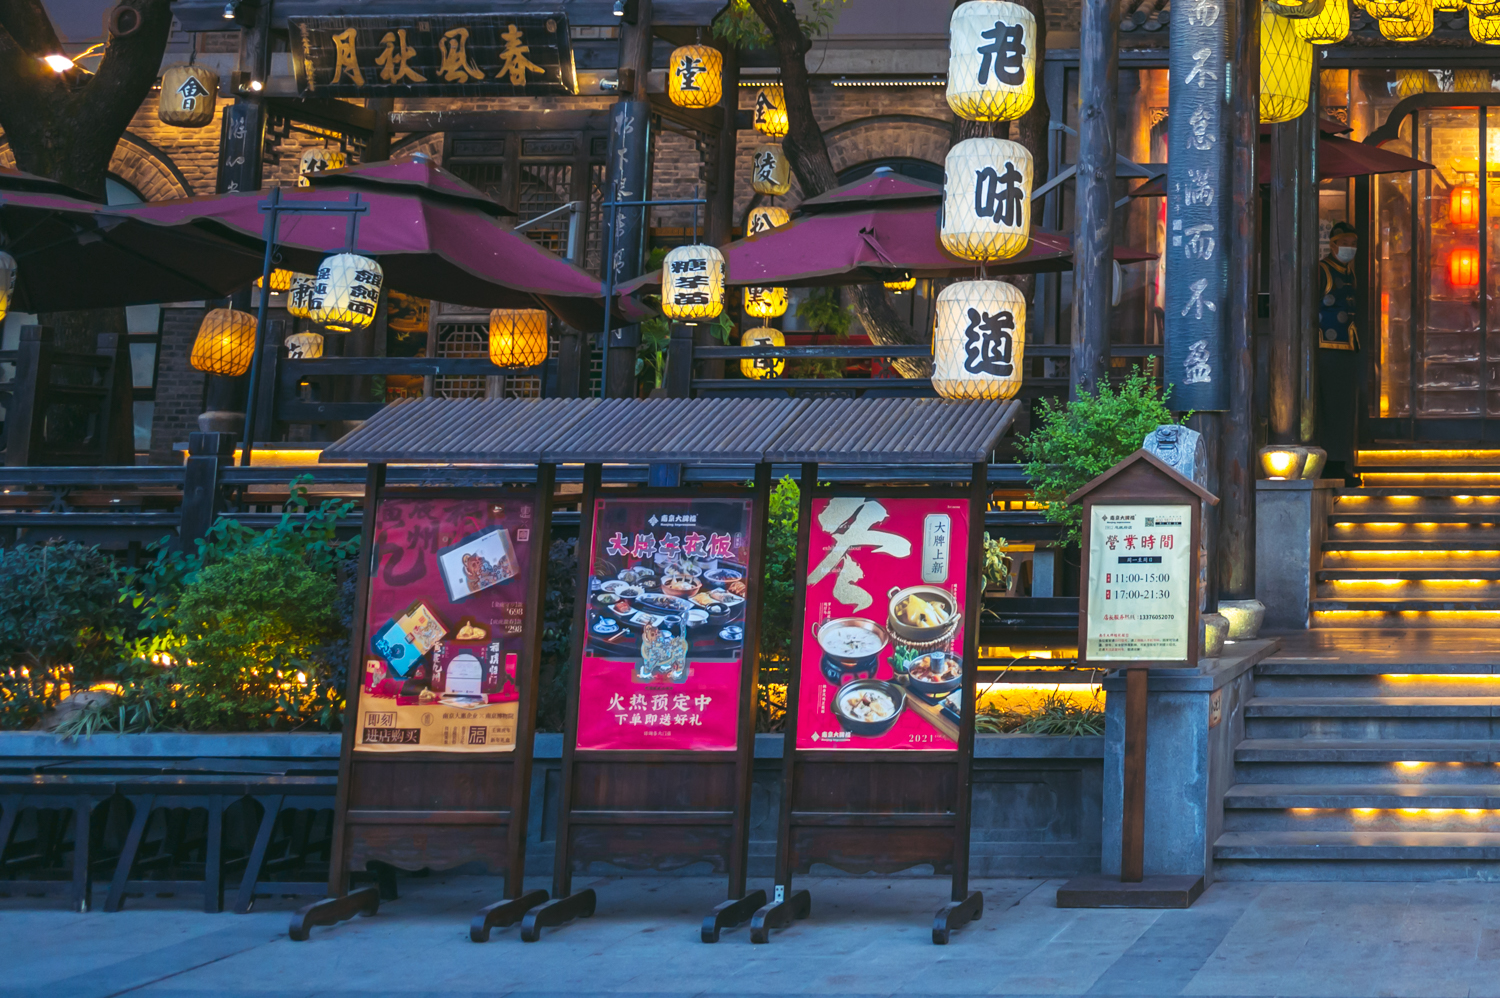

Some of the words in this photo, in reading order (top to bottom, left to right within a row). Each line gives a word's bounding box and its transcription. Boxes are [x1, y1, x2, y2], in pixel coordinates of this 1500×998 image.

[329, 23, 546, 87] 春風秋月
[675, 55, 707, 92] 堂
[175, 75, 211, 111] 會
[670, 257, 710, 306] 糖芋苗
[606, 532, 736, 559] 大牌年夜饭
[931, 521, 946, 575] 大牌上新
[1105, 534, 1174, 551] 營業時間
[806, 497, 912, 614] 冬
[1114, 573, 1170, 583] 11:00-15:00
[1114, 589, 1170, 599] 17:00-21:30
[606, 692, 713, 712] 火热预定中
[368, 713, 394, 726] 即刻
[614, 713, 703, 726] 下单即送好礼
[365, 729, 418, 744] 进店购买
[908, 734, 934, 743] 2021
